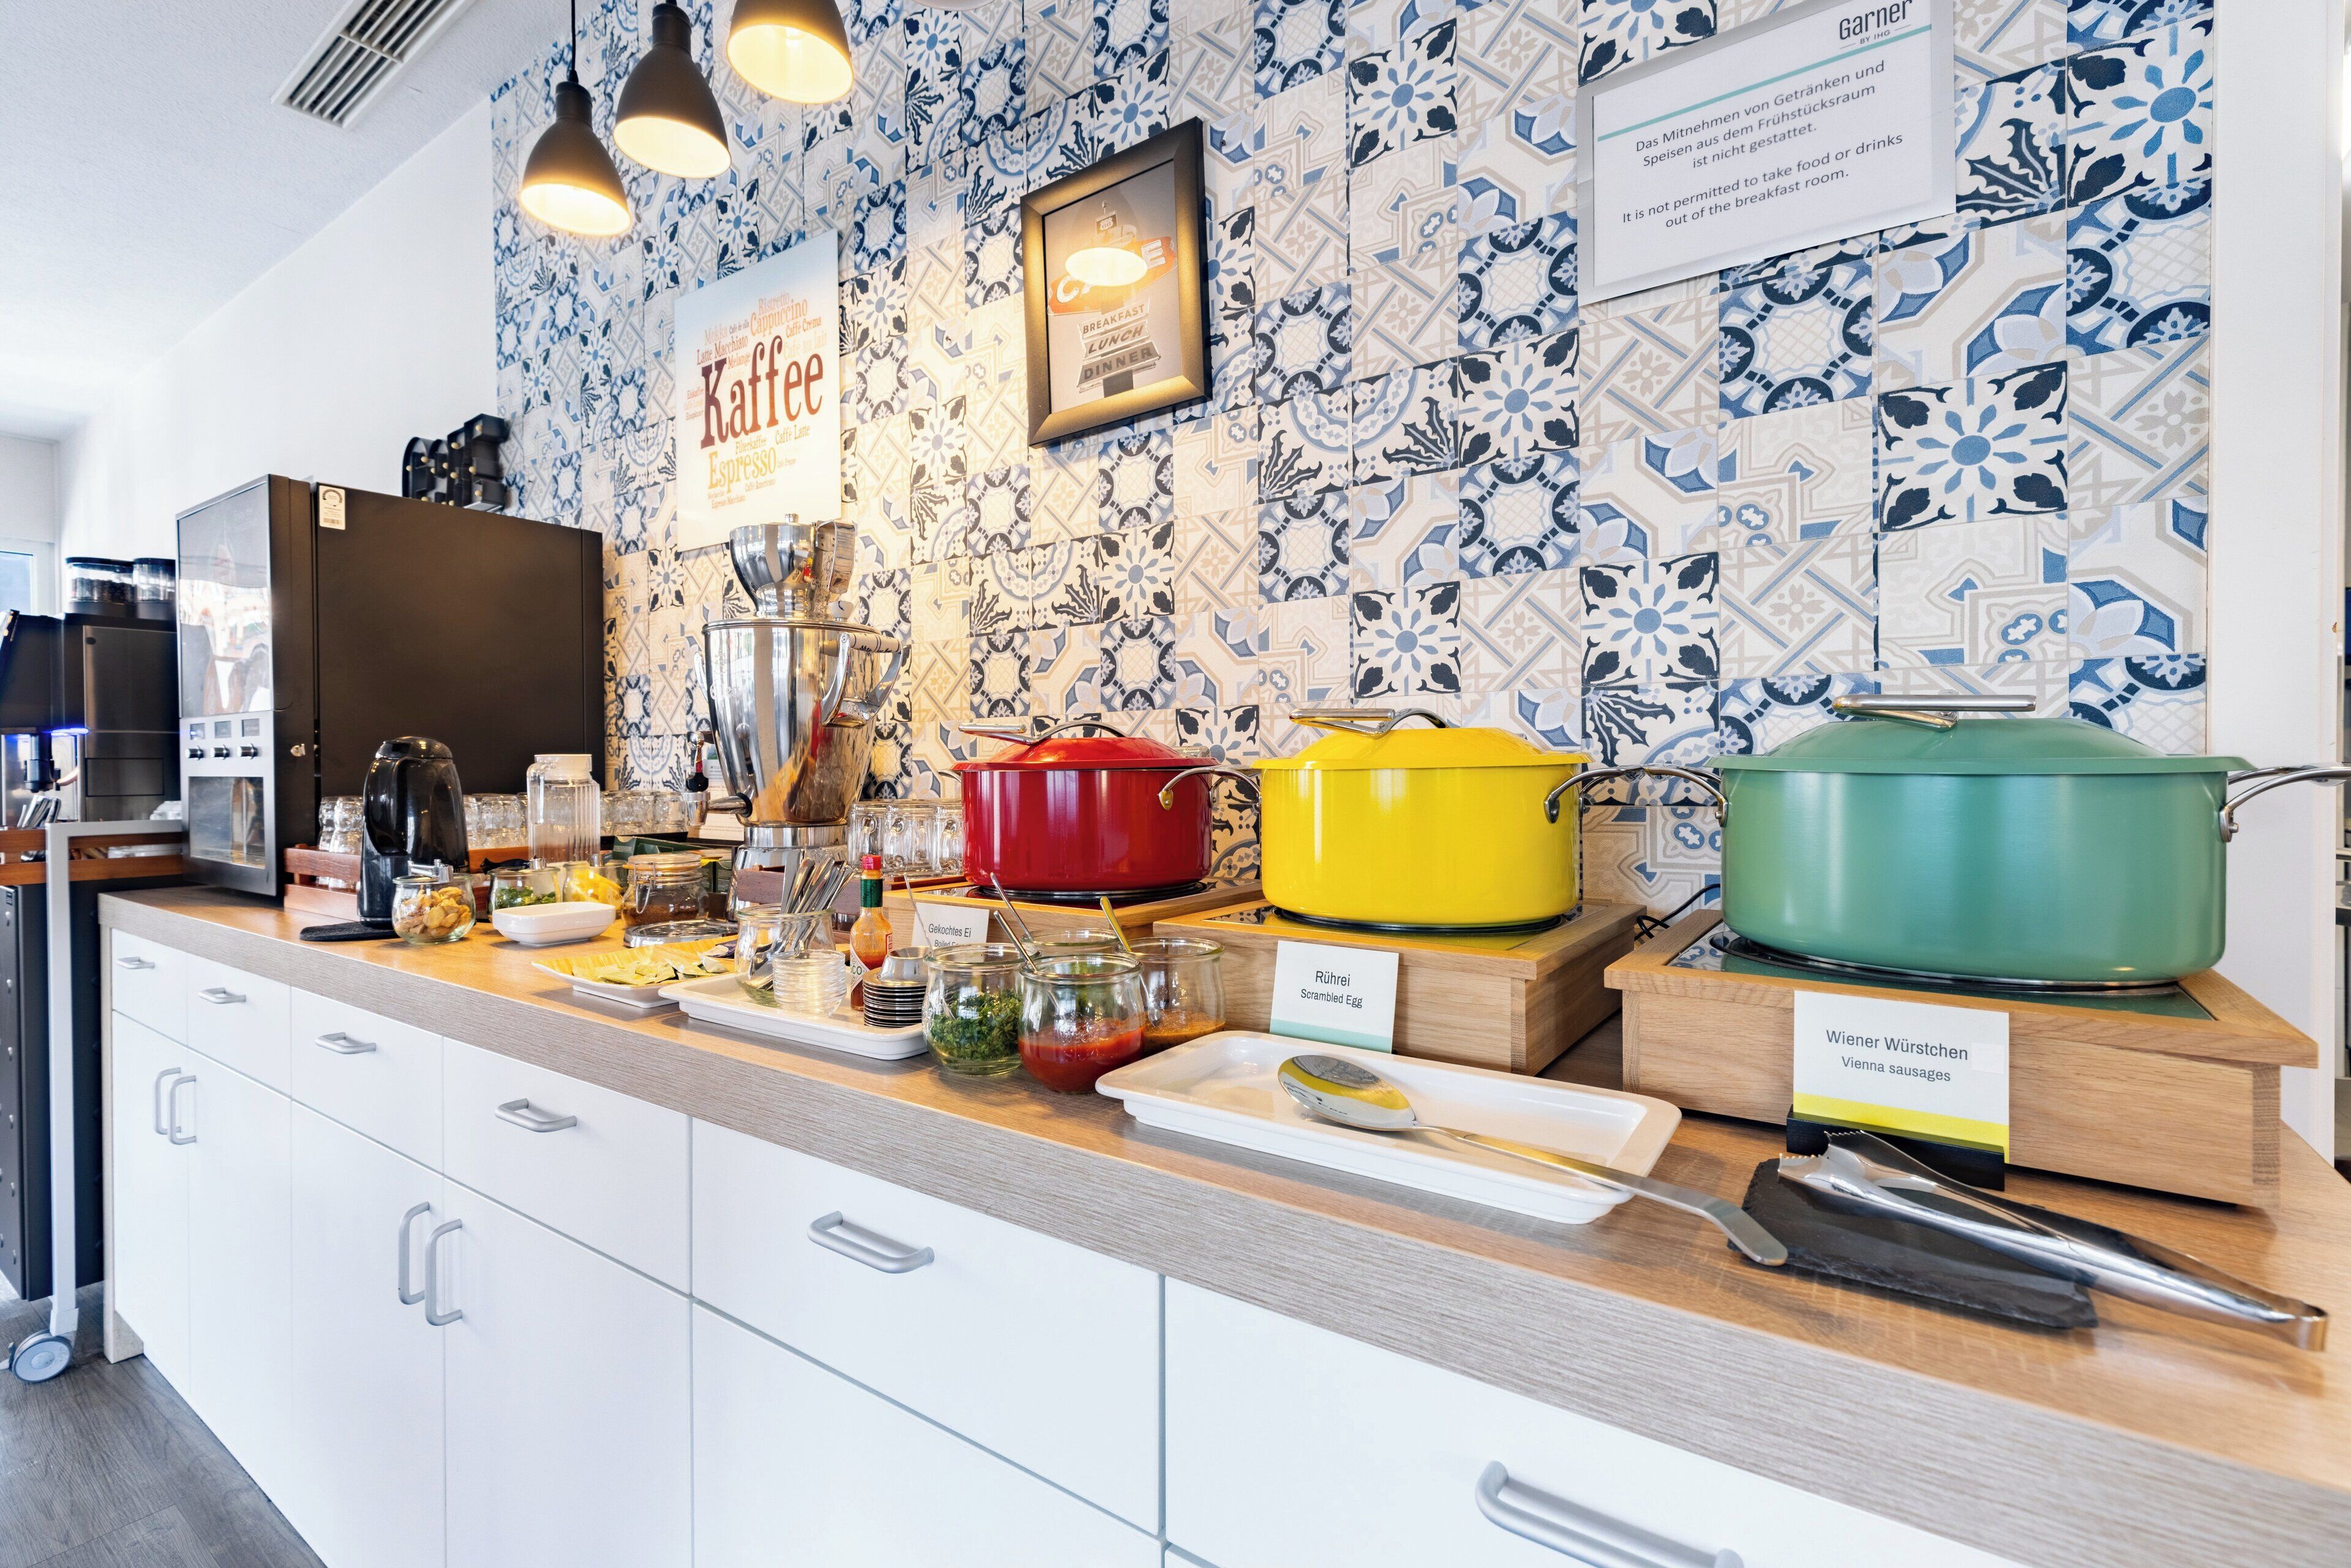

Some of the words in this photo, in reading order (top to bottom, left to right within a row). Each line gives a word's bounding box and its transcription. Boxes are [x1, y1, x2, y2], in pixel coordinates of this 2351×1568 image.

[1839, 0, 1913, 40] Garner
[1860, 36, 1870, 45] BY
[1874, 29, 1891, 40] IHG
[1636, 138, 1659, 152] Das
[1663, 111, 1740, 144] Mitnehmen
[1744, 102, 1769, 116] von
[1774, 75, 1850, 106] Getränken
[1855, 60, 1884, 80] und
[1643, 144, 1692, 167] Speisen
[1696, 135, 1719, 150] aus
[1723, 125, 1753, 141] dem
[1758, 85, 1875, 130] Frühstücksraum
[1693, 156, 1708, 168] ist
[1712, 144, 1745, 162] nicht
[1749, 122, 1817, 153] gestattet.
[1623, 212, 1632, 223] It
[1635, 209, 1644, 220] is
[1648, 201, 1670, 216] not
[1674, 179, 1739, 211] permitted
[1744, 177, 1758, 187] to
[1762, 167, 1792, 182] take
[1796, 152, 1830, 173] food
[1835, 149, 1851, 161] or
[1856, 135, 1903, 155] drinks
[1665, 214, 1688, 228] out
[1692, 206, 1706, 220] of
[1708, 202, 1731, 216] the
[1735, 181, 1801, 208] breakfast
[1805, 170, 1849, 189] room.
[1056, 239, 1166, 304] CE
[751, 299, 808, 337] Cappuccino
[803, 317, 822, 332] Crema
[1083, 304, 1144, 334] BREAKFAST
[705, 323, 727, 345] Mokka
[1089, 324, 1144, 354] LUNCH
[697, 349, 712, 366] Latte
[714, 336, 748, 358] Macchiato
[728, 353, 751, 369] Melange
[1084, 347, 1153, 380] DINNER
[700, 335, 823, 449] Kaffee
[794, 424, 810, 440] Latte
[708, 447, 776, 493] Espresso
[928, 923, 962, 937] Gekochtes
[964, 928, 972, 938] Ei
[1315, 970, 1351, 986] Rührei
[1300, 988, 1344, 1003] Scrambled
[1346, 995, 1363, 1009] Egg
[1826, 1029, 1880, 1049] Wiener
[1884, 1036, 1968, 1060] Würstchen
[1841, 1056, 1885, 1073] Vienna
[1889, 1064, 1951, 1082] sausages
